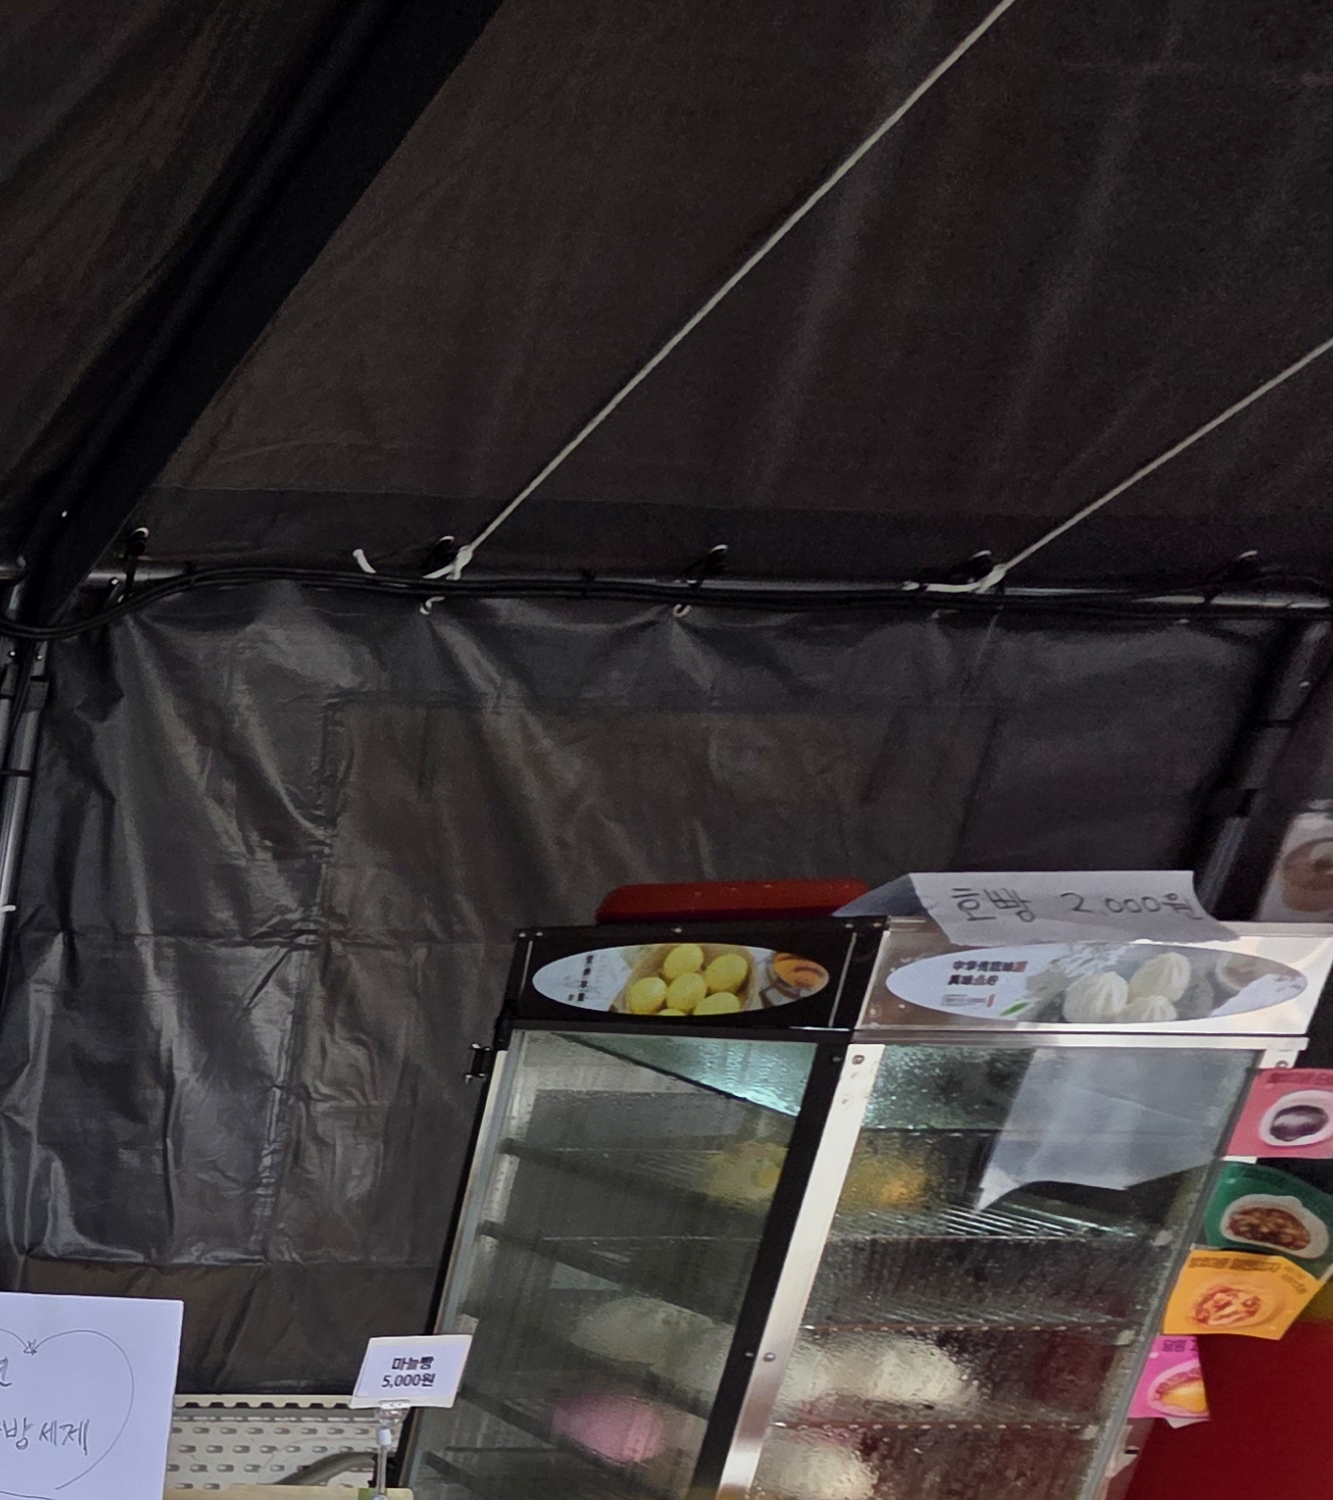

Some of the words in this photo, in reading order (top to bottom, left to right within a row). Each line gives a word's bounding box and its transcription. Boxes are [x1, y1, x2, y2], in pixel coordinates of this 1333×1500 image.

[951, 887, 1035, 923] 호빵
[391, 1356, 434, 1371] 마늘빵
[381, 1373, 436, 1388] 5,000원
